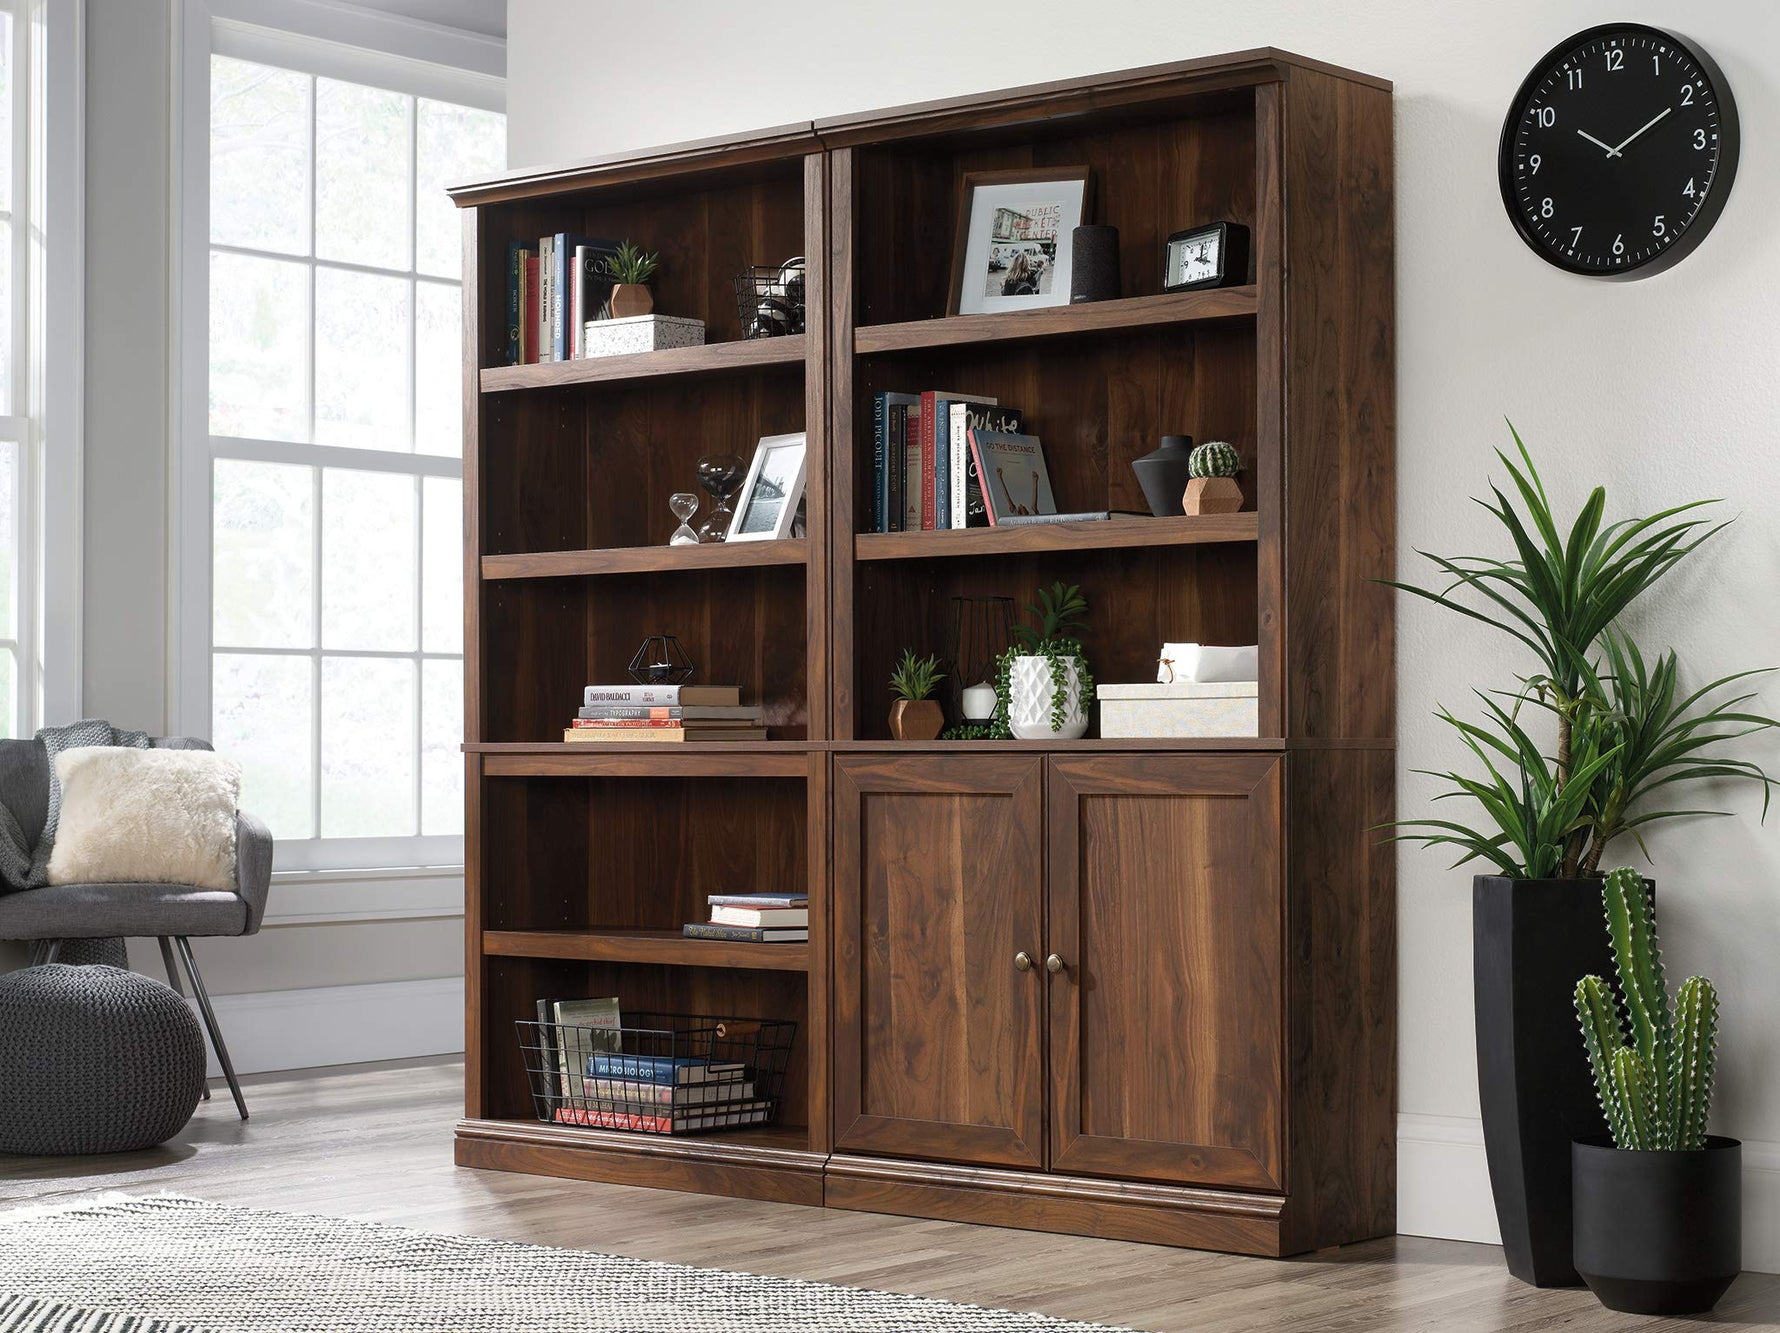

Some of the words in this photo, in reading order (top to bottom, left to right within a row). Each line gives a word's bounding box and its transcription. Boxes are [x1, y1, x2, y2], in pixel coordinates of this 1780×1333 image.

[1604, 49, 1624, 71] 12
[1652, 55, 1660, 76] 1
[1566, 68, 1583, 90] 11
[1680, 84, 1694, 107] 2
[1536, 106, 1556, 128] 10
[1693, 128, 1707, 150] 3
[1529, 154, 1542, 175] 9
[1682, 177, 1696, 198] 4
[1026, 205, 1060, 217] PUBLIC
[1541, 197, 1554, 218] 8
[1020, 229, 1058, 241] CENTER
[1570, 225, 1584, 248] 7
[1652, 215, 1665, 237] 5
[1612, 233, 1624, 255] 6
[1184, 260, 1189, 269] 9
[874, 396, 883, 421] JODI
[966, 410, 1018, 434] White
[874, 425, 882, 470] PICOULT
[994, 443, 1007, 451] THE
[1007, 444, 1036, 454] DISTANCE
[590, 692, 605, 701] DAVID
[606, 692, 631, 701] BALDACCI
[610, 709, 641, 717] TYPOGRAPHY
